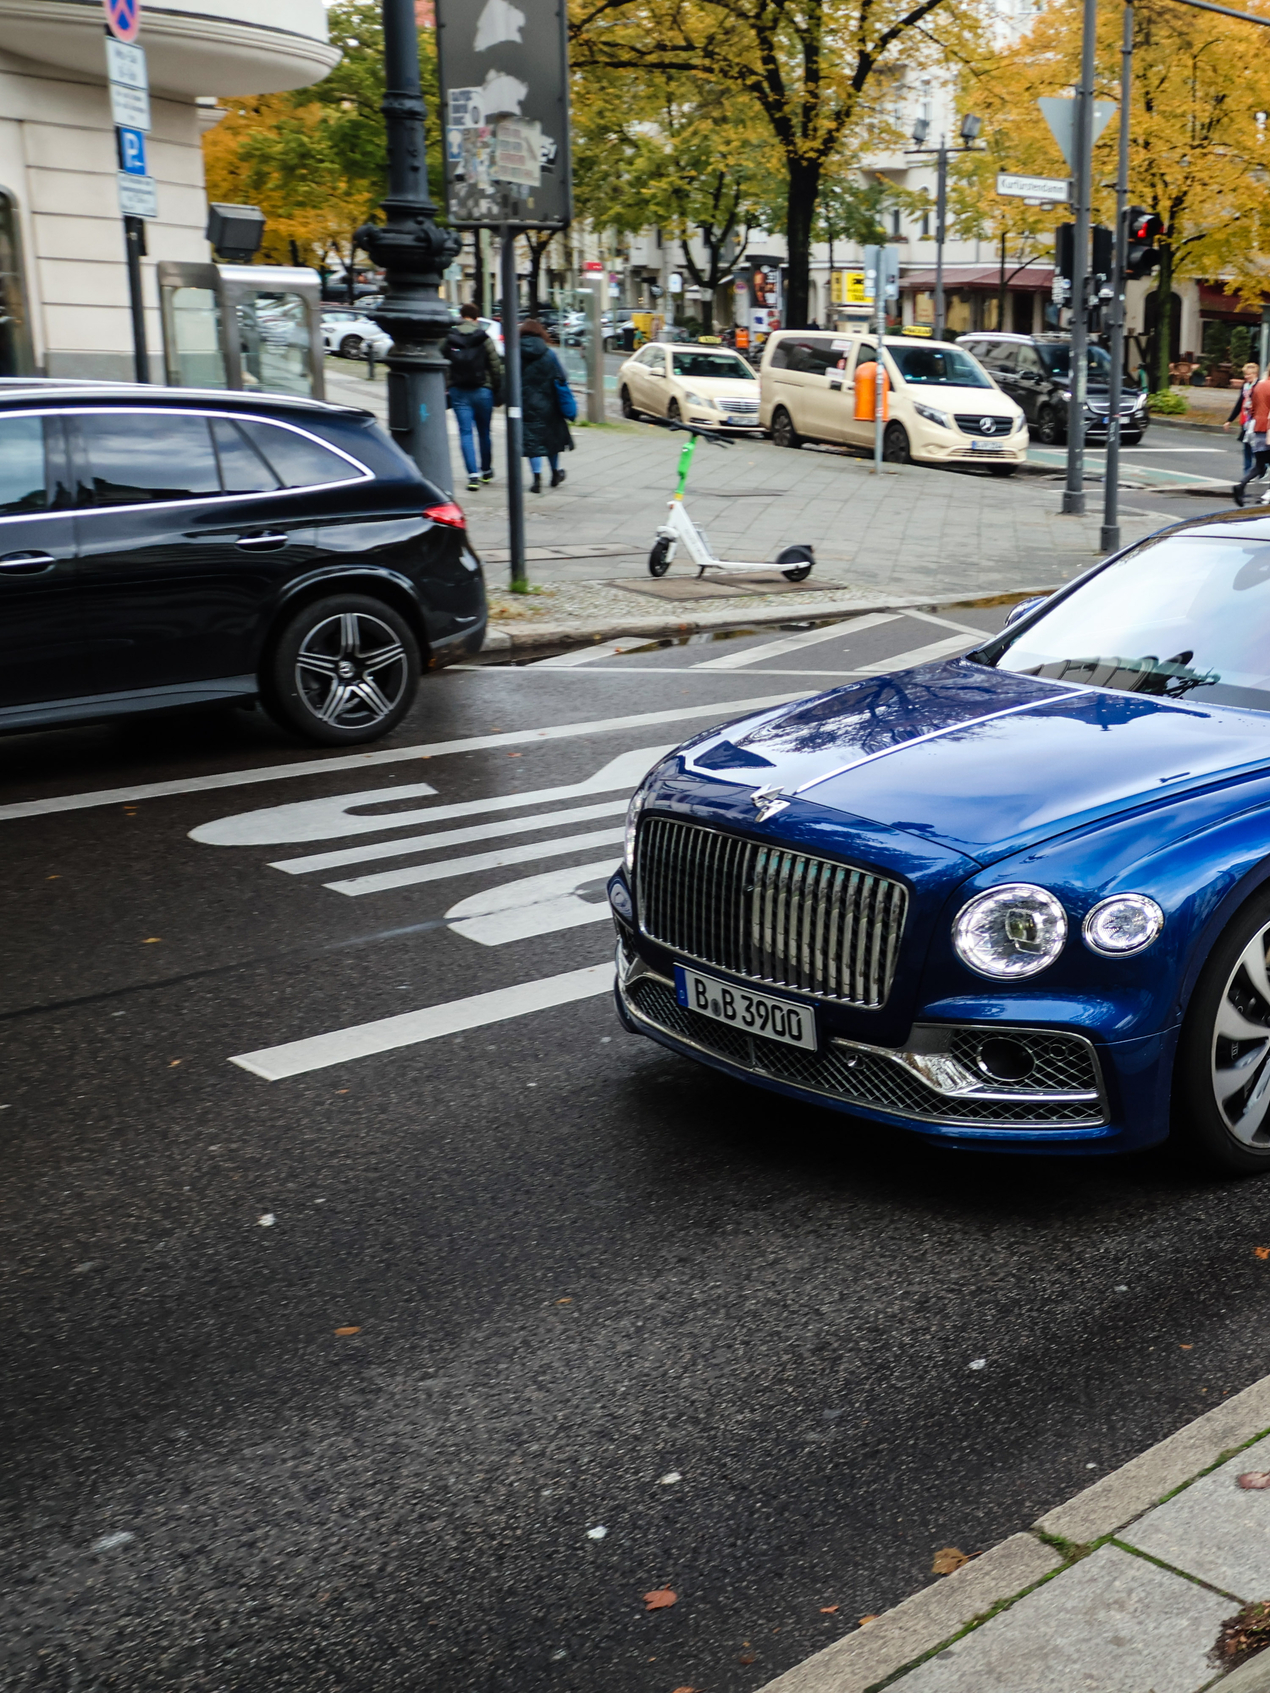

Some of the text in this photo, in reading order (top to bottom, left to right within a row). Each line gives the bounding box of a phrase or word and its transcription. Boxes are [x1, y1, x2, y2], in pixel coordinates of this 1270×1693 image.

[124, 132, 140, 167] P
[694, 977, 709, 1010] B
[740, 994, 803, 1042] 3900
